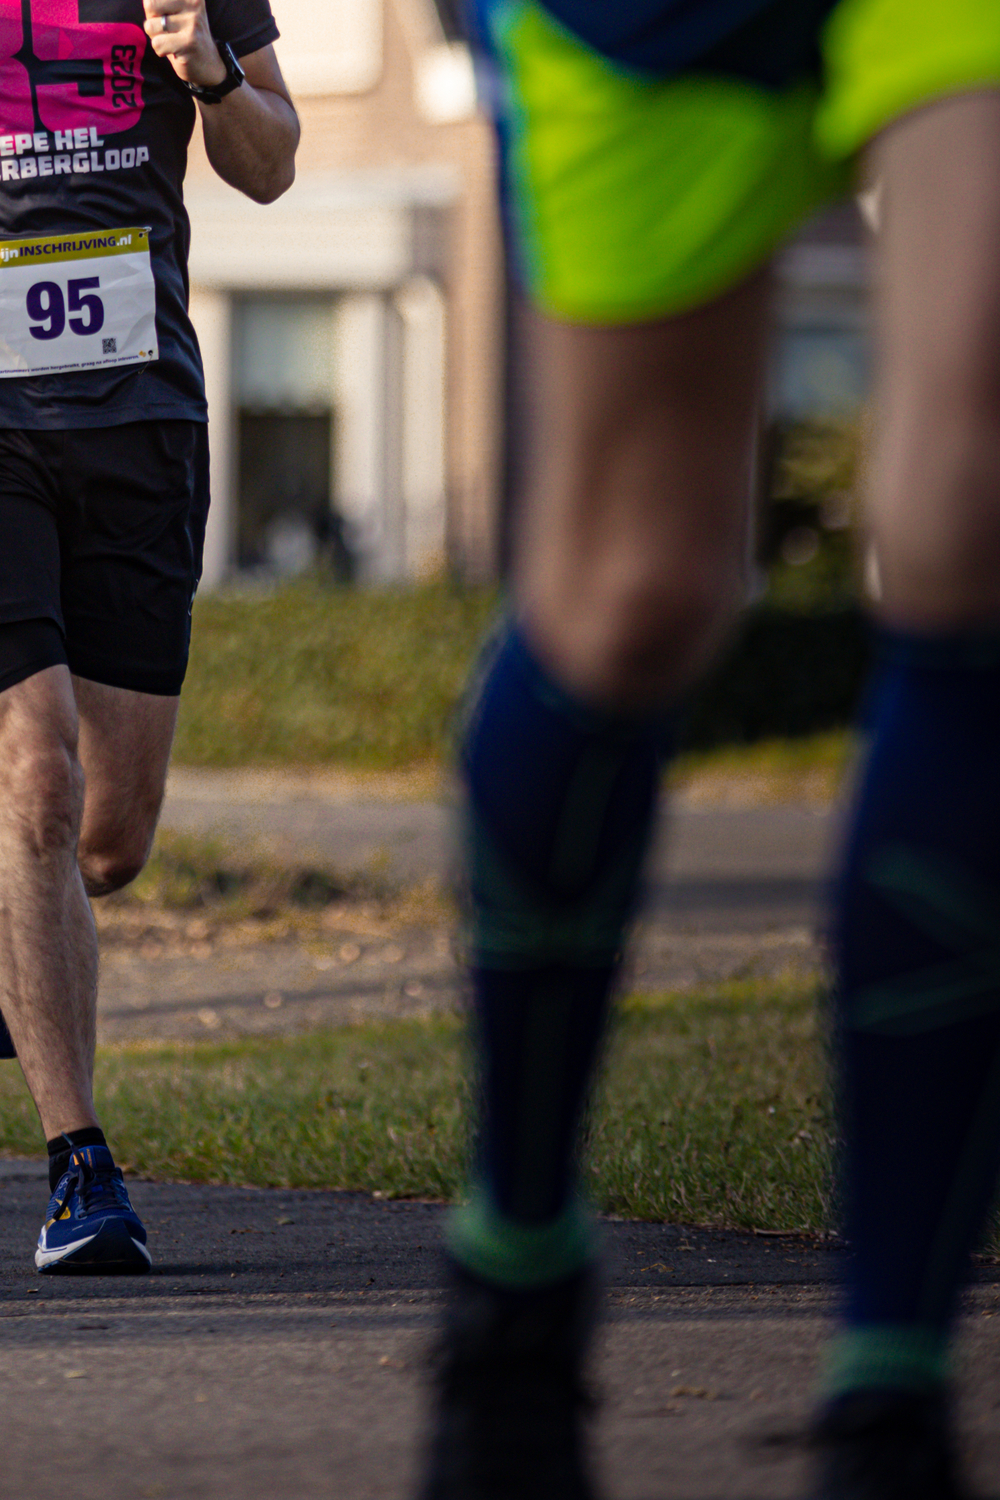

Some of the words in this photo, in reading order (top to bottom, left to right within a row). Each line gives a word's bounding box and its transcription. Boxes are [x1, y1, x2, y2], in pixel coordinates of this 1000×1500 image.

[111, 44, 137, 109] 2023
[53, 127, 104, 151] HEL
[26, 276, 104, 341] 95
